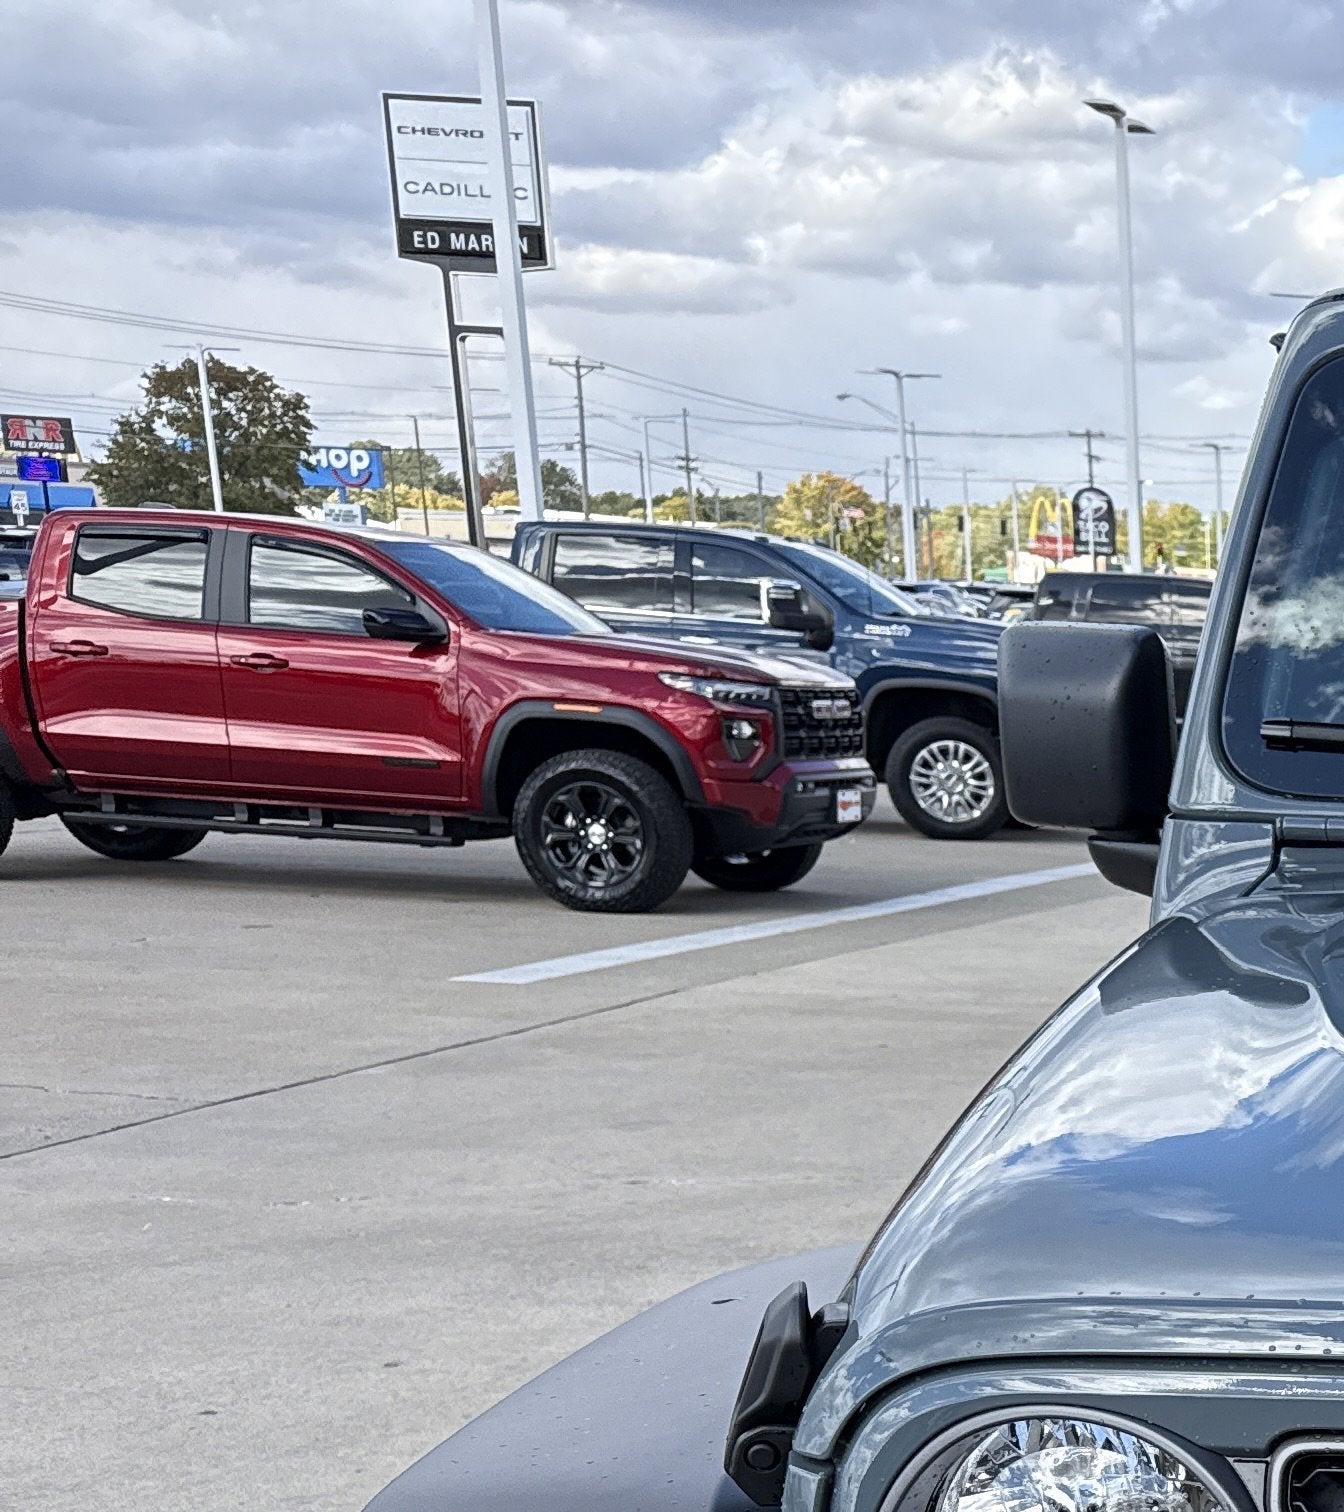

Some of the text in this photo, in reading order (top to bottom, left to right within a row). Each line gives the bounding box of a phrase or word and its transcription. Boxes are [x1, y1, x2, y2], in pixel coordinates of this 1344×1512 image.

[396, 125, 524, 141] CHEVROT
[403, 180, 529, 201] CADILLC
[412, 231, 528, 254] ED MARN
